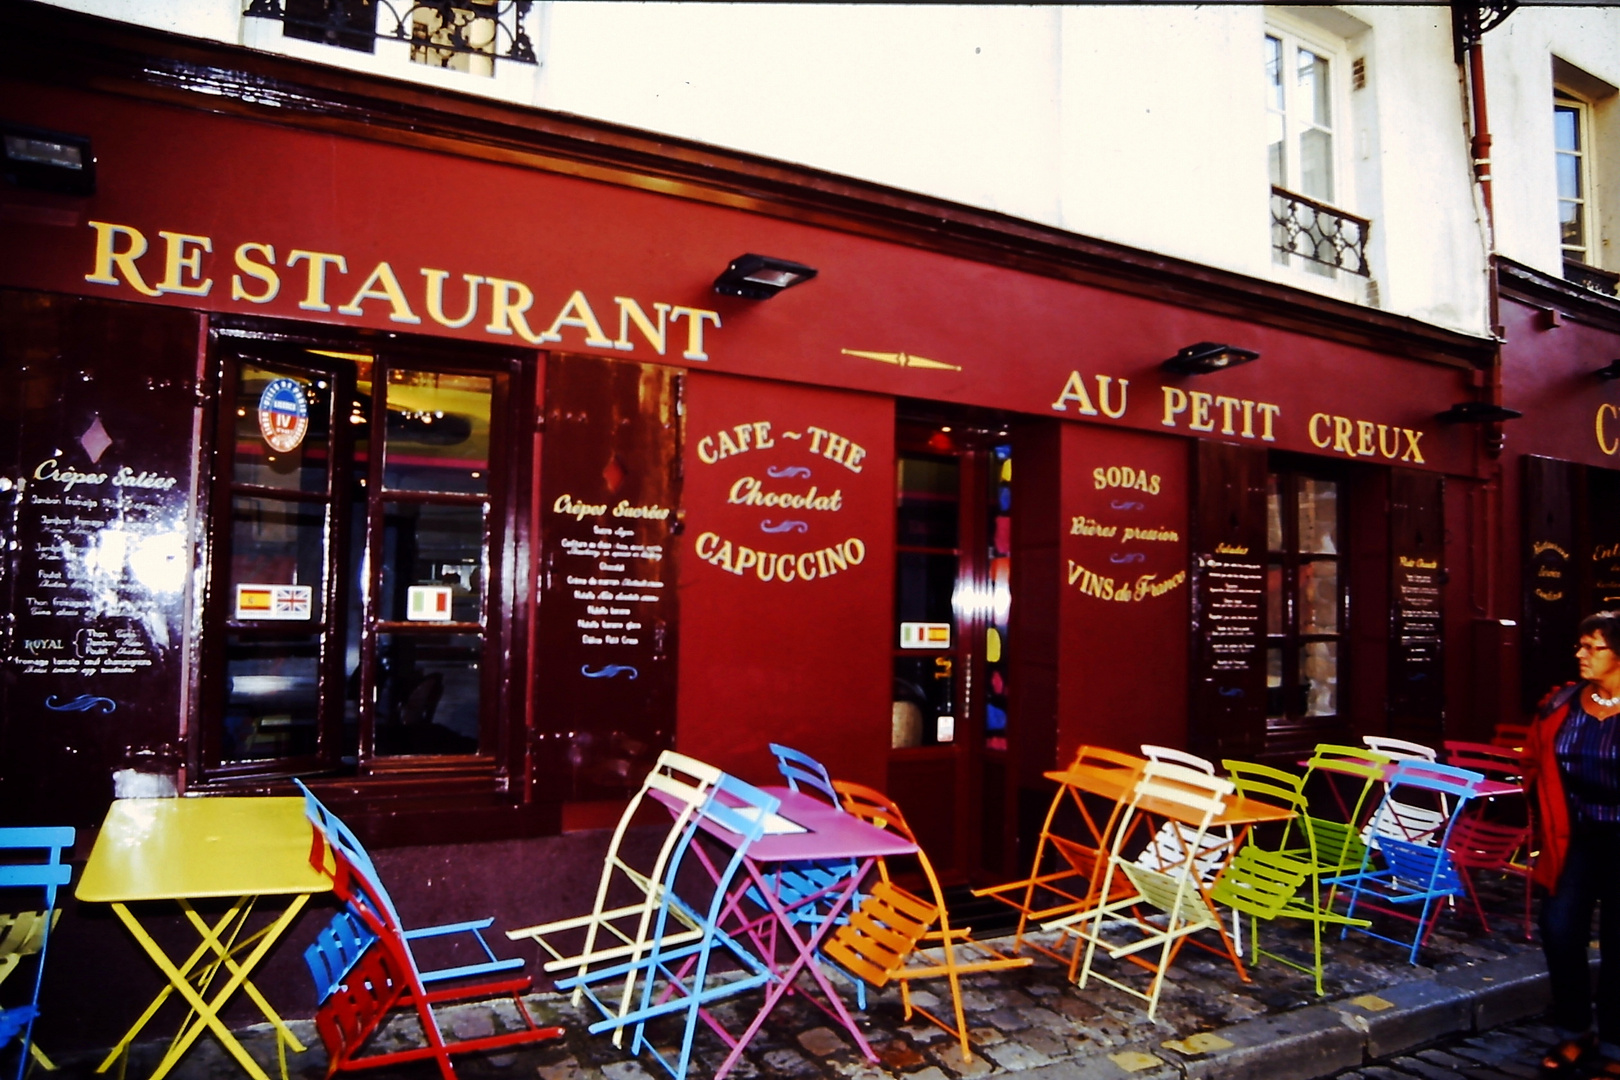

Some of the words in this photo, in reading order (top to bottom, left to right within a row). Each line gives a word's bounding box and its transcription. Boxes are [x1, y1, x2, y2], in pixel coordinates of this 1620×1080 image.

[84, 220, 722, 362] RESTAURANT
[276, 413, 292, 428] IV
[1052, 370, 1129, 419] AU
[1161, 385, 1280, 442] PETIT
[1308, 412, 1426, 465] CREUX
[1595, 403, 1620, 456] C
[697, 421, 774, 464] CAFE
[807, 426, 866, 473] THE
[33, 458, 108, 492] Crêpes
[112, 466, 177, 491] Salées
[1093, 467, 1161, 495] SODAS
[554, 494, 607, 521] Crêpes
[612, 500, 670, 520] Sucrées
[727, 476, 842, 511] Chocolat
[1121, 526, 1179, 543] pression
[695, 532, 865, 582] CAPUCCINO
[1068, 560, 1114, 600] VINS
[1114, 583, 1132, 602] de
[1133, 573, 1186, 602] France
[26, 597, 48, 606] Thon
[25, 639, 64, 655] ROYAL
